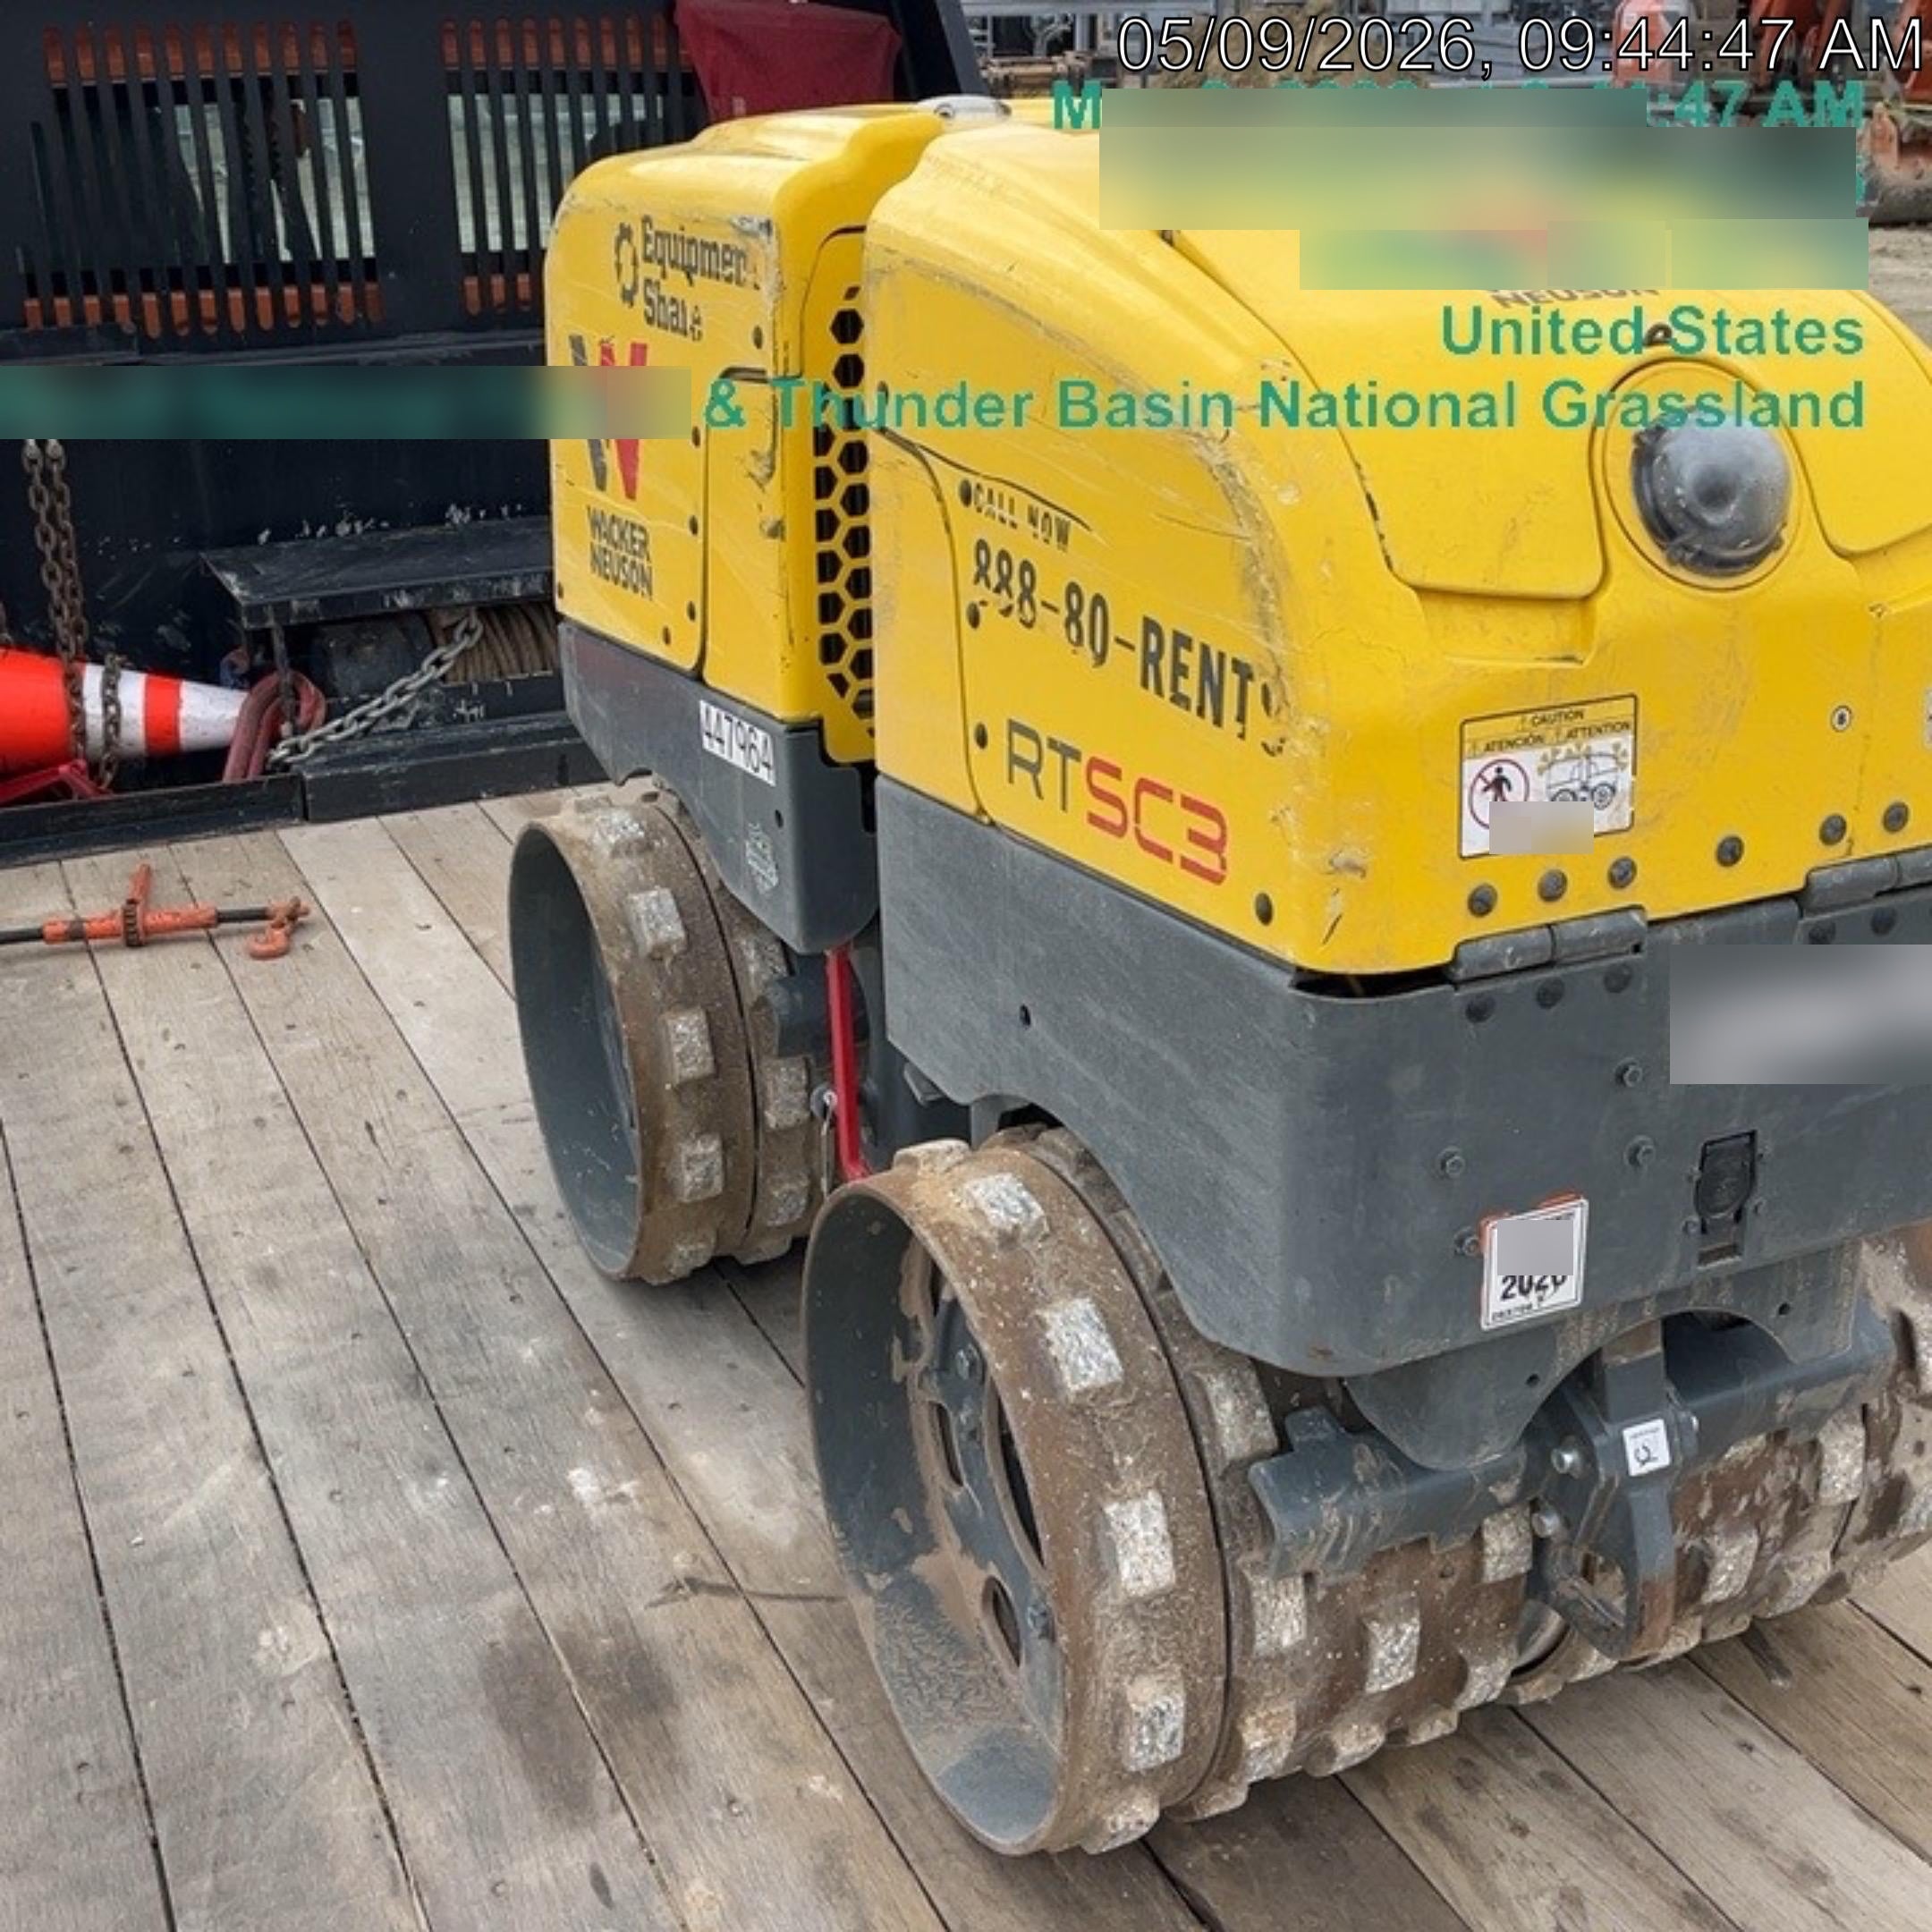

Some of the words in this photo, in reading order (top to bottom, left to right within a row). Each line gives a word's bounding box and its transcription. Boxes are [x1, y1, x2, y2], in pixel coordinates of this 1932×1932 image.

[641, 214, 761, 291] Equipmen
[1491, 289, 1659, 309] NEUS
[587, 504, 651, 562] WACKER
[973, 483, 1017, 530] CALL
[1027, 504, 1071, 553] NOW
[590, 541, 652, 600] NEUSON
[703, 704, 773, 783] 447964
[1530, 709, 1584, 726] CAUTION
[1566, 722, 1630, 740] ATTENTION
